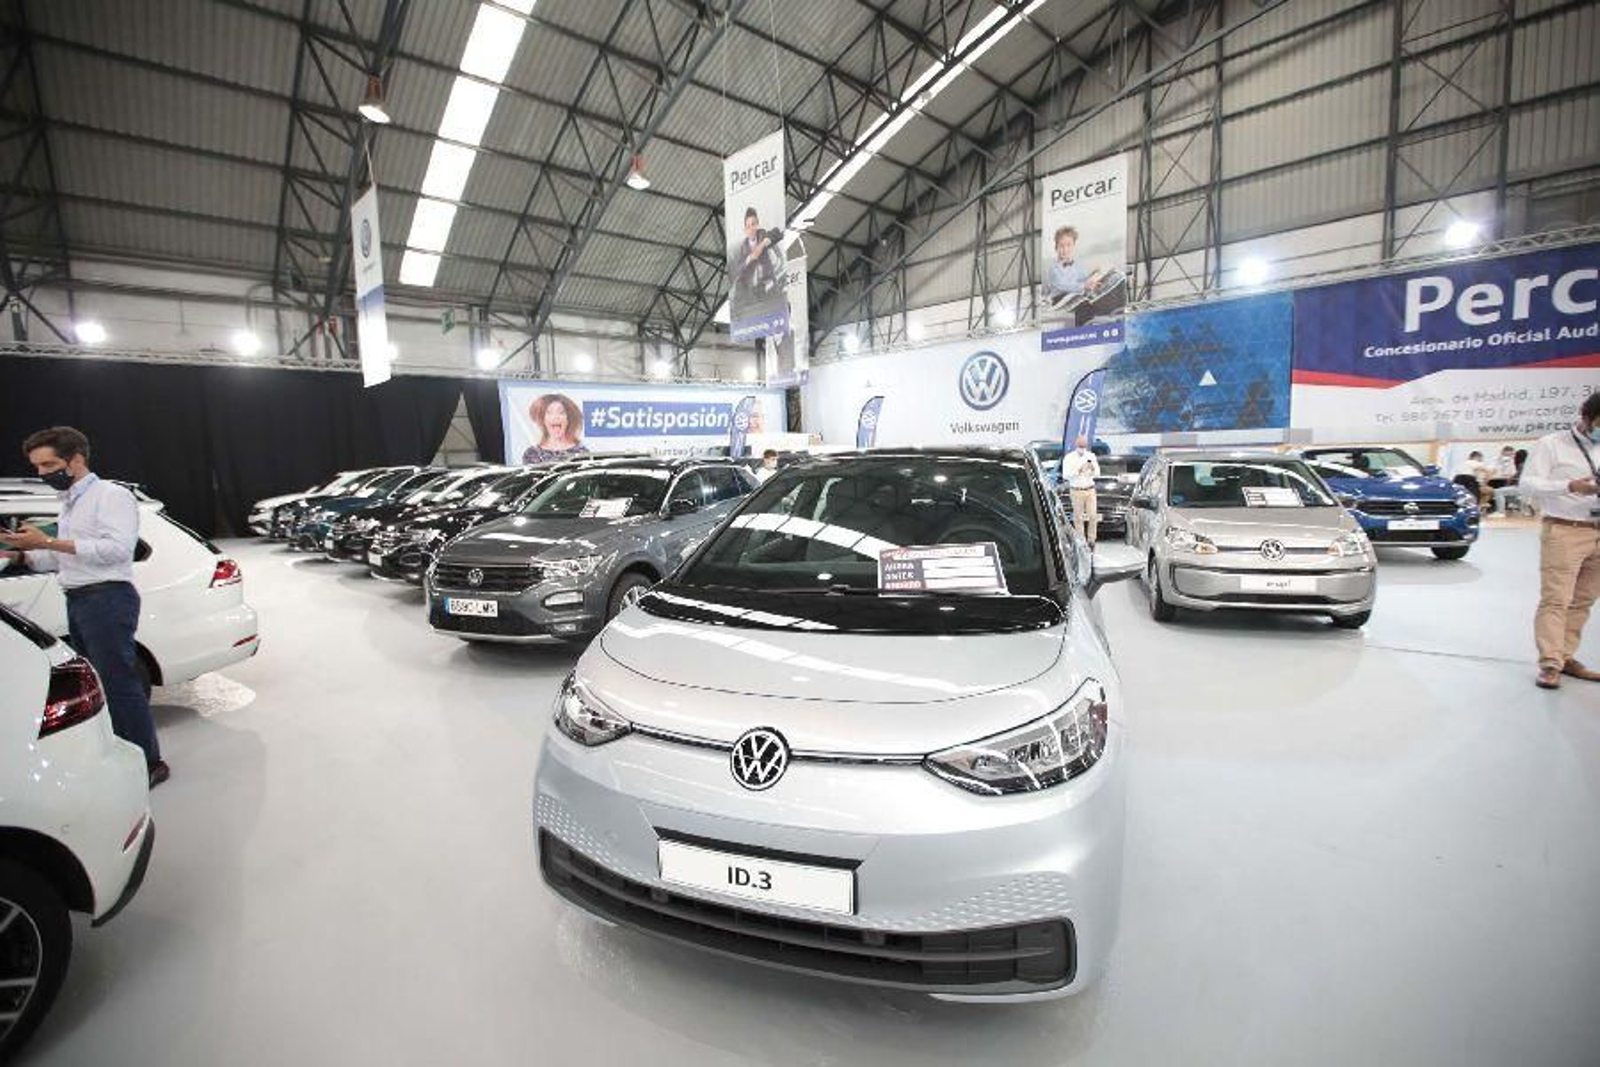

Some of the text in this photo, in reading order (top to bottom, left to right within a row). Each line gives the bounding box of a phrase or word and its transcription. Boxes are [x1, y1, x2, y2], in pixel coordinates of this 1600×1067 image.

[730, 154, 777, 191] Percar
[1051, 176, 1117, 207] Percar
[1404, 269, 1600, 333] Perc
[1364, 323, 1600, 358] Concesionario Oficial Aud
[591, 406, 729, 433] #Satispasión
[949, 421, 1020, 435] Volkswagen
[728, 866, 772, 890] ID.3
